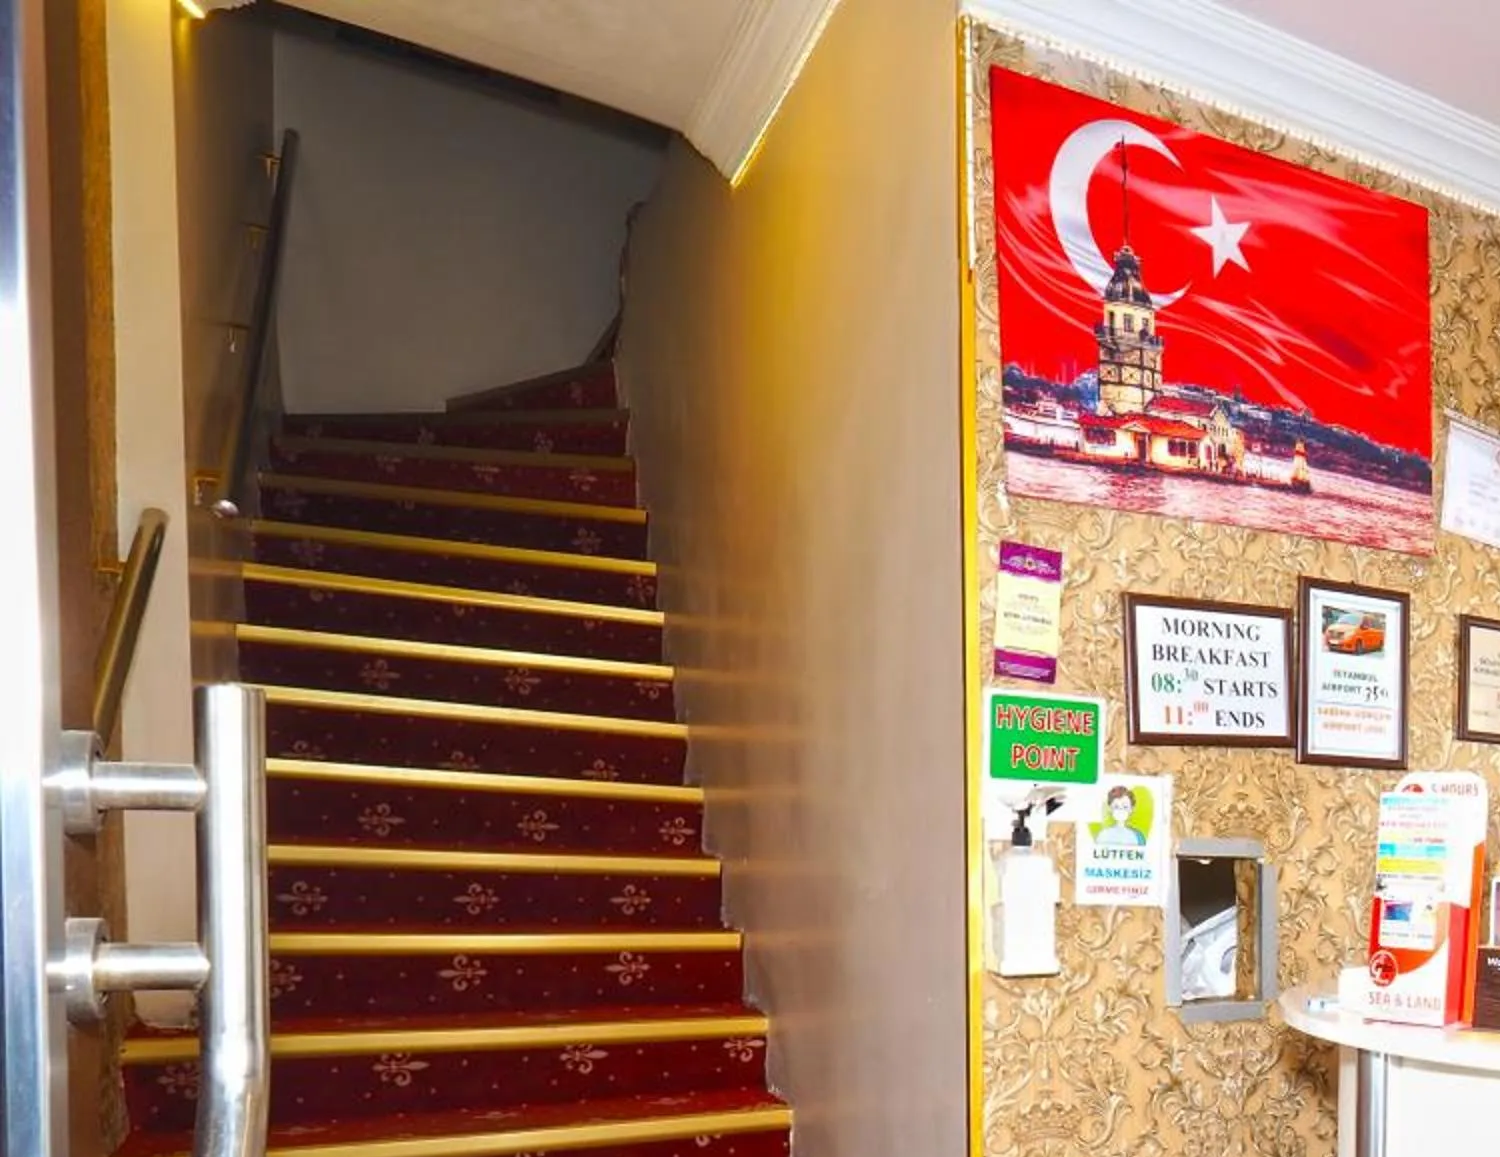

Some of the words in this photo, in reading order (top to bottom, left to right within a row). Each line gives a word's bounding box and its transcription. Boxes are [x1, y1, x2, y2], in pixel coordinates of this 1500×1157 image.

[1162, 616, 1261, 642] MORNING
[1152, 643, 1271, 668] BREAKFAST
[1202, 678, 1278, 699] STARTS
[995, 703, 1094, 736] HYGIENE
[1215, 709, 1266, 729] ENDS
[1011, 743, 1080, 773] POINT
[1441, 783, 1479, 797] HOURS
[1084, 865, 1153, 880] MASKESİZ
[1368, 991, 1391, 1005] SEA
[1406, 995, 1441, 1011] LAND
